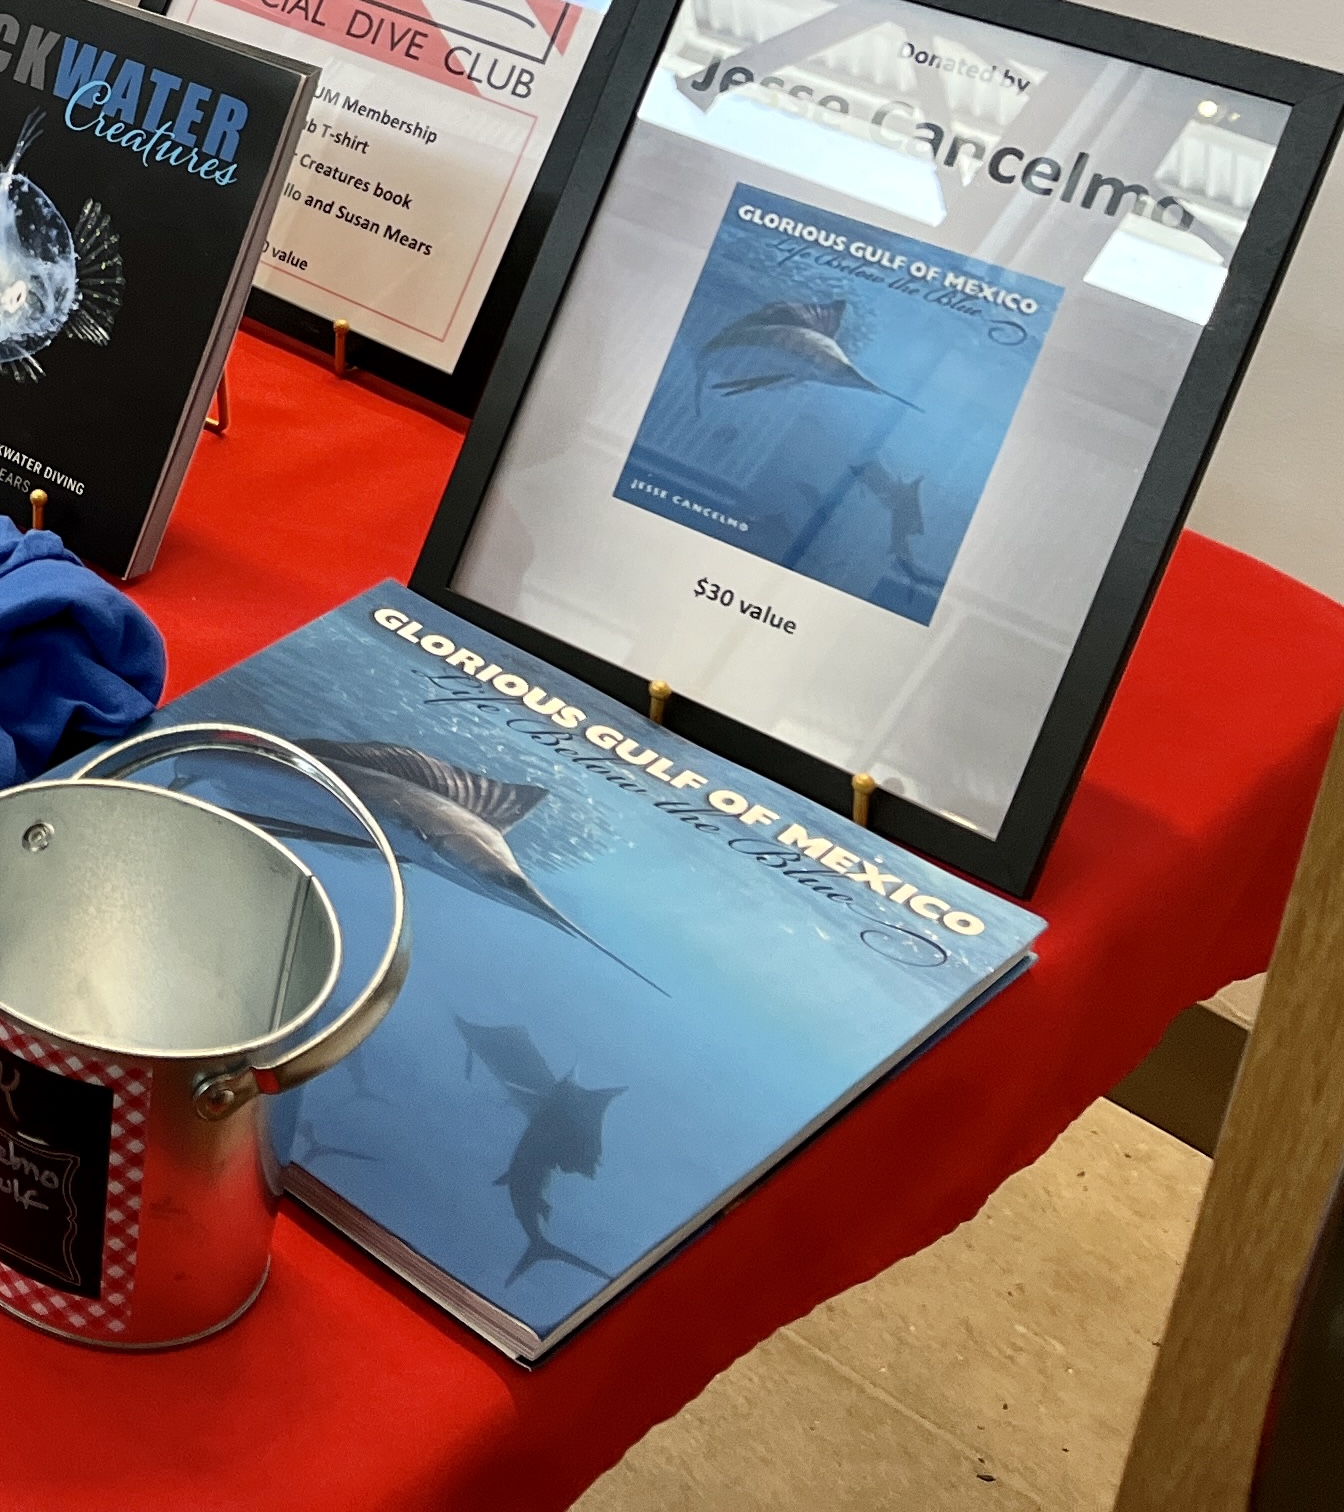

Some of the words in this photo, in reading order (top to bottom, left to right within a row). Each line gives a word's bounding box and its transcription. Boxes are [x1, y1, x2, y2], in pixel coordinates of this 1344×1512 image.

[346, 9, 428, 61] DIVE
[444, 46, 535, 100] CLUB
[64, 79, 238, 186] Creatures
[321, 123, 370, 155] T-shirt
[342, 95, 438, 145] Membership
[299, 153, 371, 193] Creatures
[373, 181, 414, 210] book
[868, 96, 1196, 232] Cancelmo
[304, 193, 335, 215] and
[335, 205, 380, 235] Susan
[382, 225, 434, 257] Mears
[766, 238, 812, 268] Life
[272, 246, 309, 271] value
[737, 204, 847, 253] GLORIOUS
[849, 242, 909, 272] GULF
[909, 260, 940, 286] OF
[943, 272, 1039, 316] MEXICO
[43, 466, 85, 496] DIVING
[631, 478, 669, 501] JESSE
[672, 494, 750, 533] CANCELMO
[693, 576, 734, 610] $30
[739, 598, 798, 636] value
[372, 607, 587, 731] GLORIOUS
[584, 724, 709, 794] GULF
[707, 788, 781, 828] OF
[777, 822, 986, 938] MEXICO
[410, 667, 502, 717] Life
[505, 714, 647, 799] Below
[653, 791, 721, 835] the
